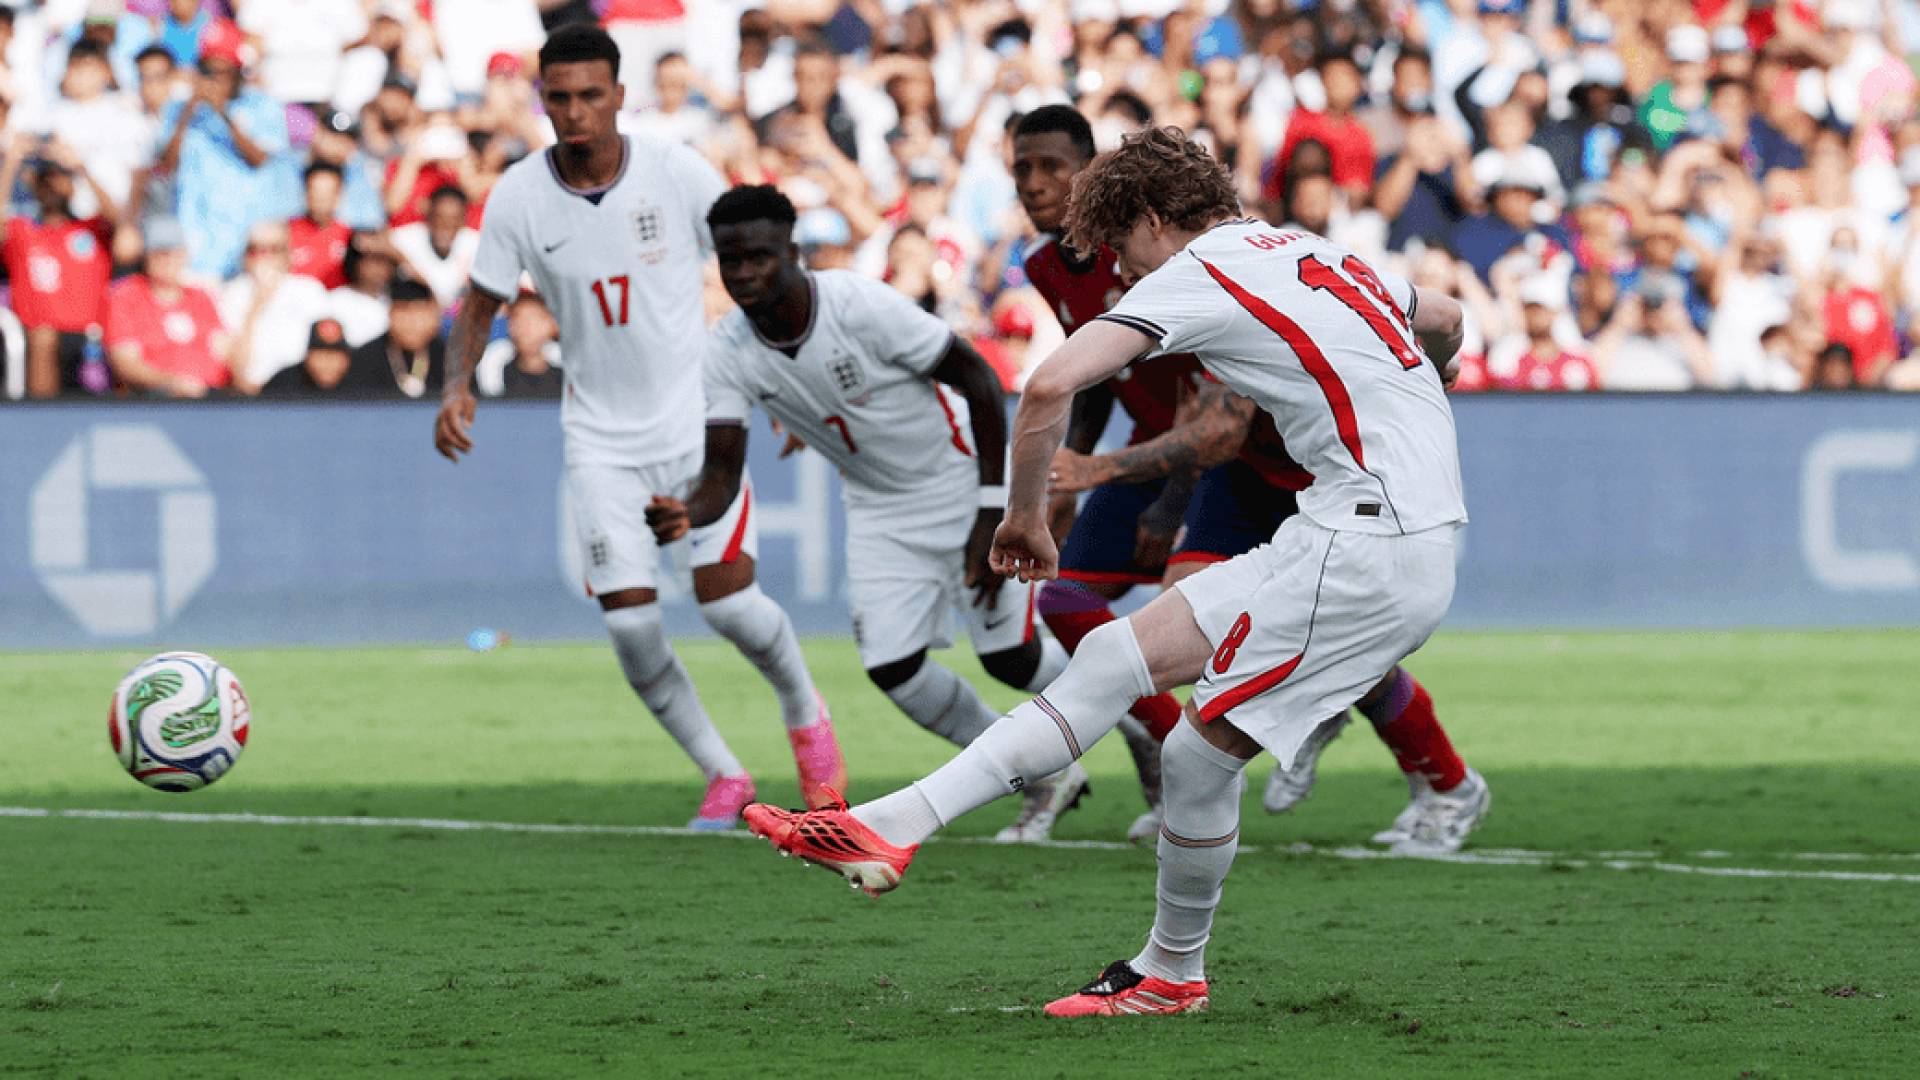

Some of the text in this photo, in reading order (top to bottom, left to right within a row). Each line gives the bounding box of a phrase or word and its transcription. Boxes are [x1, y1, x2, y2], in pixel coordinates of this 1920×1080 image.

[591, 274, 630, 328] 17
[823, 415, 860, 455] 7
[1213, 611, 1251, 674] 8
